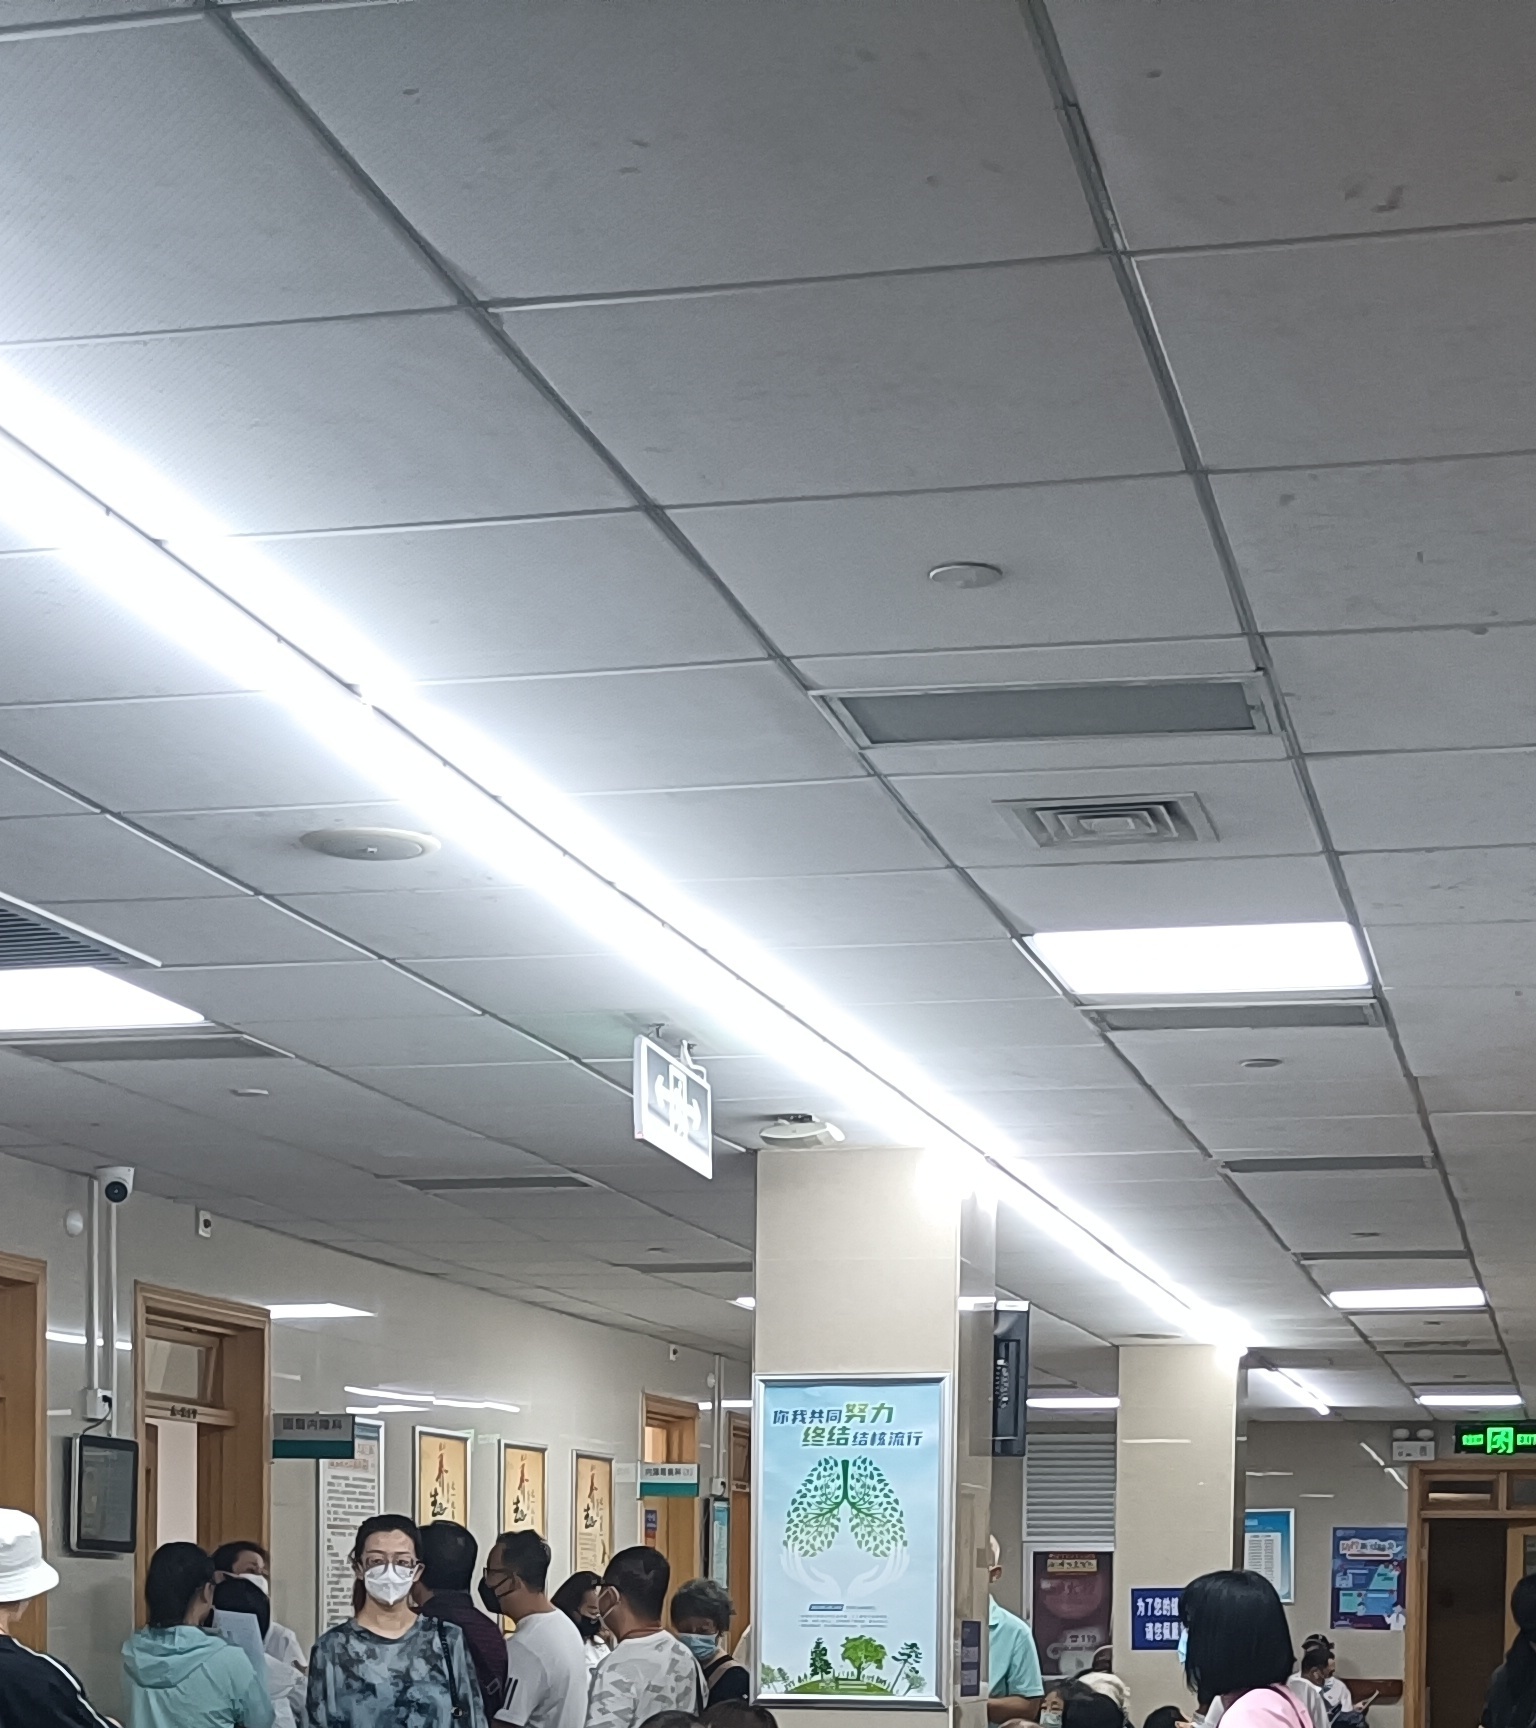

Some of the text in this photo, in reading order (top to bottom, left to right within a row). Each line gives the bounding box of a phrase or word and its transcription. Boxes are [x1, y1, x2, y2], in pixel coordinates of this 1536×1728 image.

[772, 1402, 895, 1425] 你我共同努力
[801, 1425, 924, 1447] 终结结核流行
